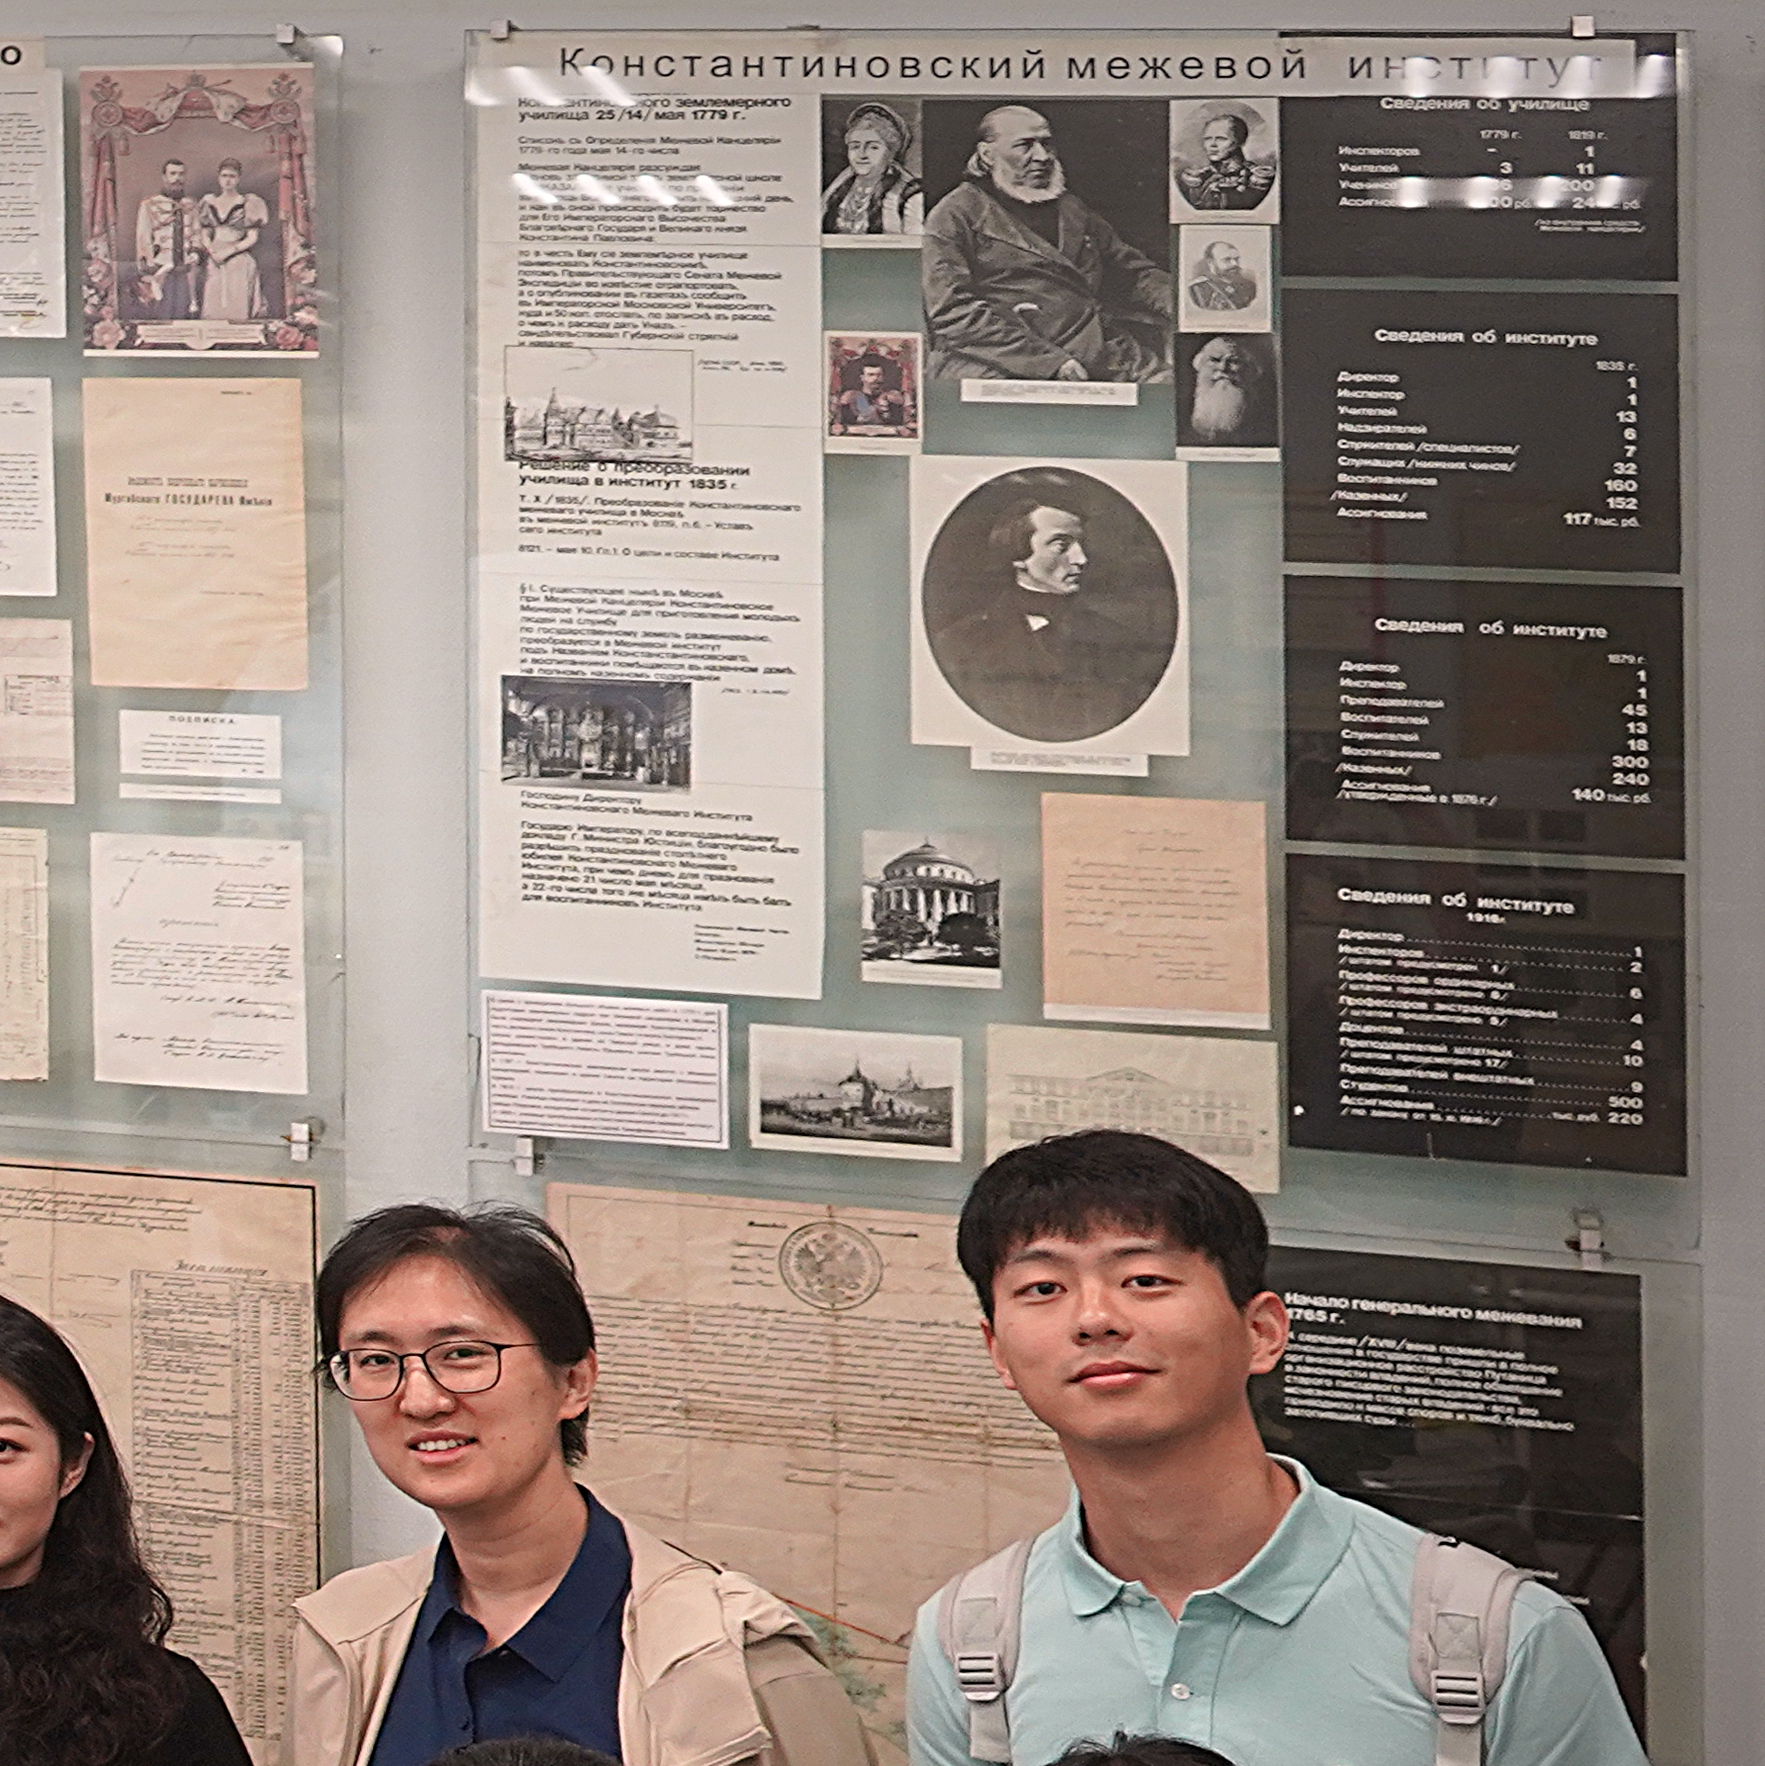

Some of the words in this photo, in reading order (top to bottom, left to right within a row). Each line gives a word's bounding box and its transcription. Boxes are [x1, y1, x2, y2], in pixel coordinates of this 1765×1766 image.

[560, 46, 1046, 79] Константиновский
[1068, 47, 1307, 80] межевой
[1349, 52, 1603, 87] институт
[675, 98, 791, 110] землемерного
[1380, 97, 1469, 111] Сведения
[1477, 100, 1501, 110] об
[1508, 100, 1590, 112] училище
[519, 110, 589, 122] училища
[596, 110, 615, 120] 25
[655, 110, 686, 120] мая
[693, 110, 727, 120] 1779
[1584, 146, 1594, 157] 1
[1500, 162, 1512, 173] 3
[1576, 163, 1594, 174] 11
[1375, 329, 1465, 343] Сведения
[1472, 330, 1497, 343] об
[1505, 333, 1598, 348] институте
[1627, 377, 1637, 389] 1
[1628, 394, 1637, 406] 1
[1616, 411, 1637, 423] 13
[1624, 428, 1637, 440] 6
[1624, 445, 1637, 457] 7
[615, 463, 749, 476] преобразовании
[1614, 463, 1637, 475] 32
[519, 474, 589, 487] училища
[595, 477, 603, 486] в
[609, 477, 679, 490] институт
[690, 480, 727, 490] 1835
[1605, 480, 1638, 492] 160
[1606, 497, 1638, 509] 152
[1564, 513, 1592, 525] 117
[1375, 618, 1464, 634] Сведения
[1479, 620, 1505, 635] об
[1513, 625, 1608, 640] институте
[1636, 670, 1647, 682] 1
[1637, 687, 1647, 700] 1
[1622, 704, 1648, 717] 45
[1626, 722, 1648, 734] 13
[1612, 756, 1649, 769] 300
[1613, 773, 1650, 785] 240
[1572, 788, 1605, 801] 140
[1338, 887, 1431, 904] Сведения
[1442, 892, 1467, 907] об
[1477, 897, 1575, 916] институте
[1633, 946, 1642, 958] 1
[1623, 1055, 1643, 1066] 10
[1608, 1096, 1643, 1109] 500
[1607, 1113, 1643, 1125] 220
[1284, 1292, 1349, 1309] Начало
[1351, 1299, 1474, 1320] генерального
[1475, 1309, 1583, 1329] межевания
